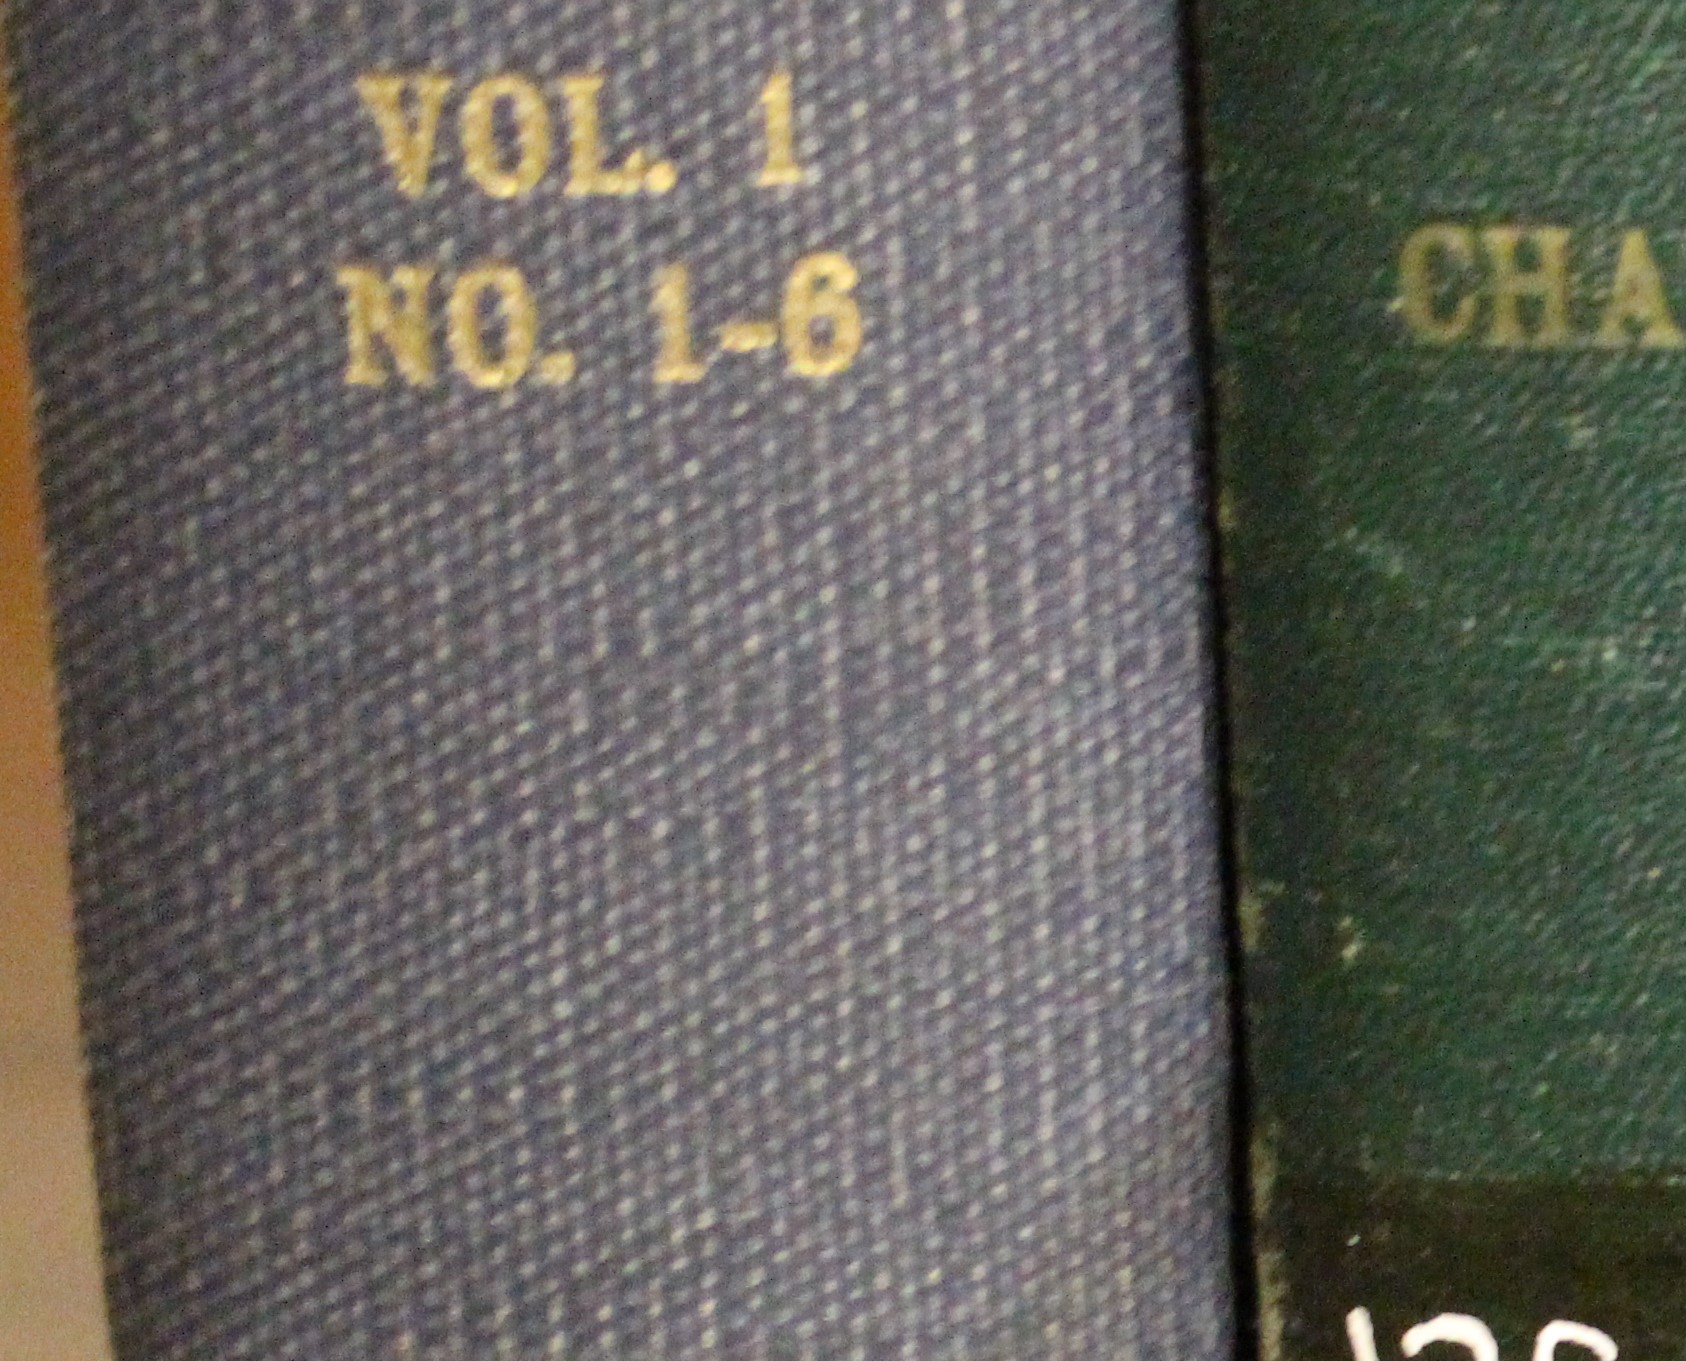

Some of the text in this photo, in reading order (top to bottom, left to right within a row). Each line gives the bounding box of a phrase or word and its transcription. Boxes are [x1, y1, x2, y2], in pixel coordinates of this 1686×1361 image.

[358, 70, 803, 197] VOL. 1
[335, 251, 864, 391] NO. 1-6
